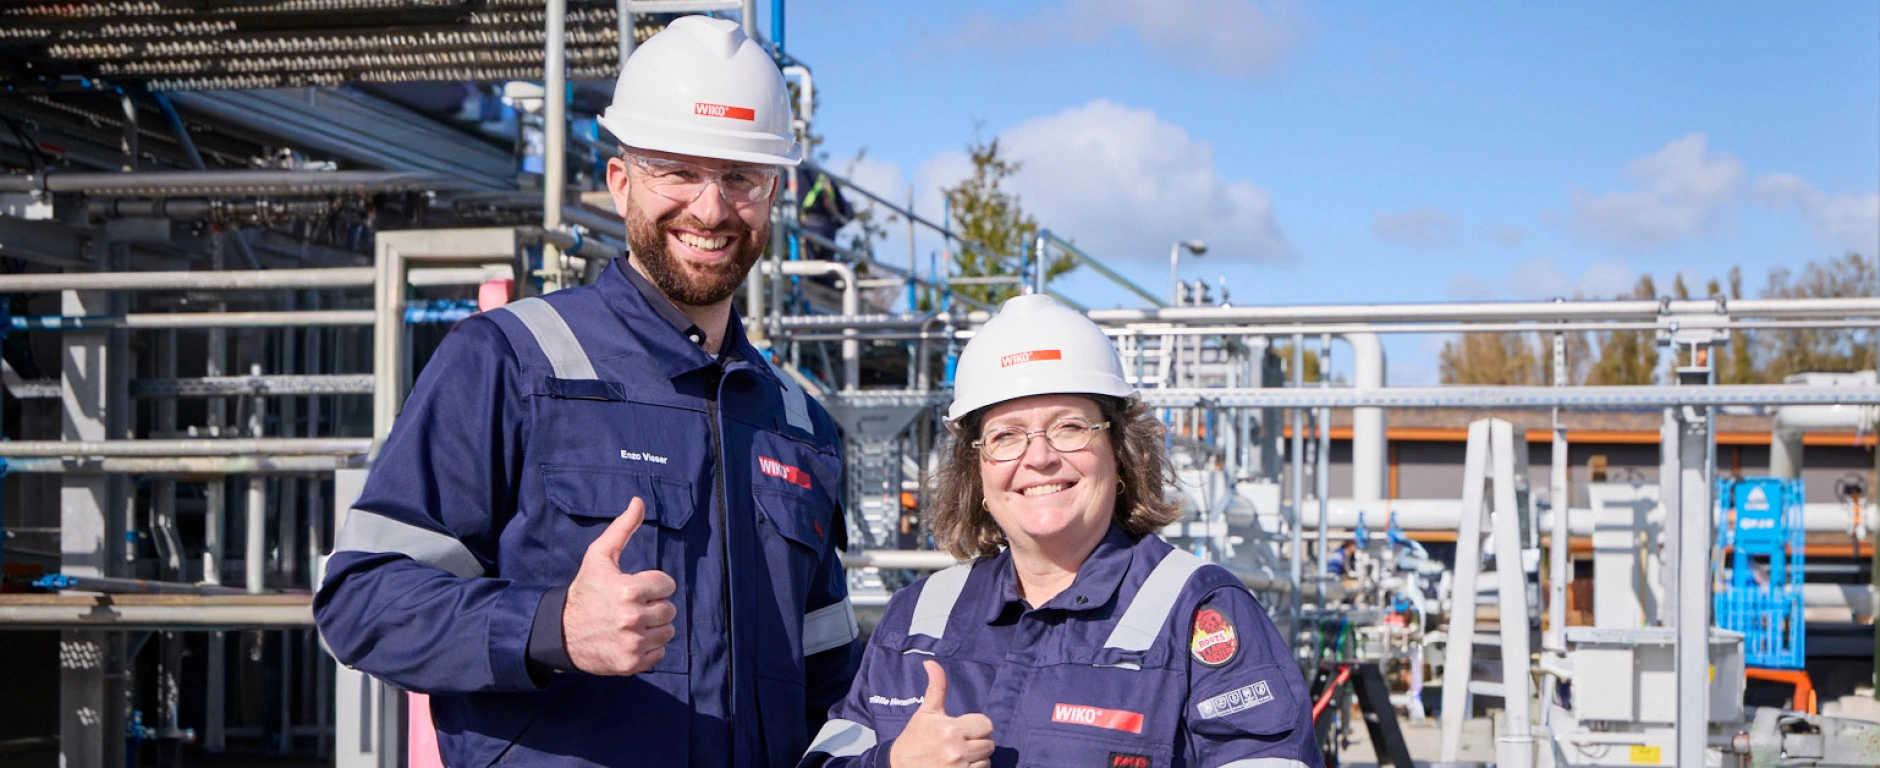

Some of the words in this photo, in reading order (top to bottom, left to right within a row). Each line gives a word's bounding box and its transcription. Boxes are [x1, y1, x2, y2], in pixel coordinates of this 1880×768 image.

[620, 449, 641, 460] Enzo
[642, 452, 668, 464] Visser
[1198, 633, 1226, 649] ROOTS
